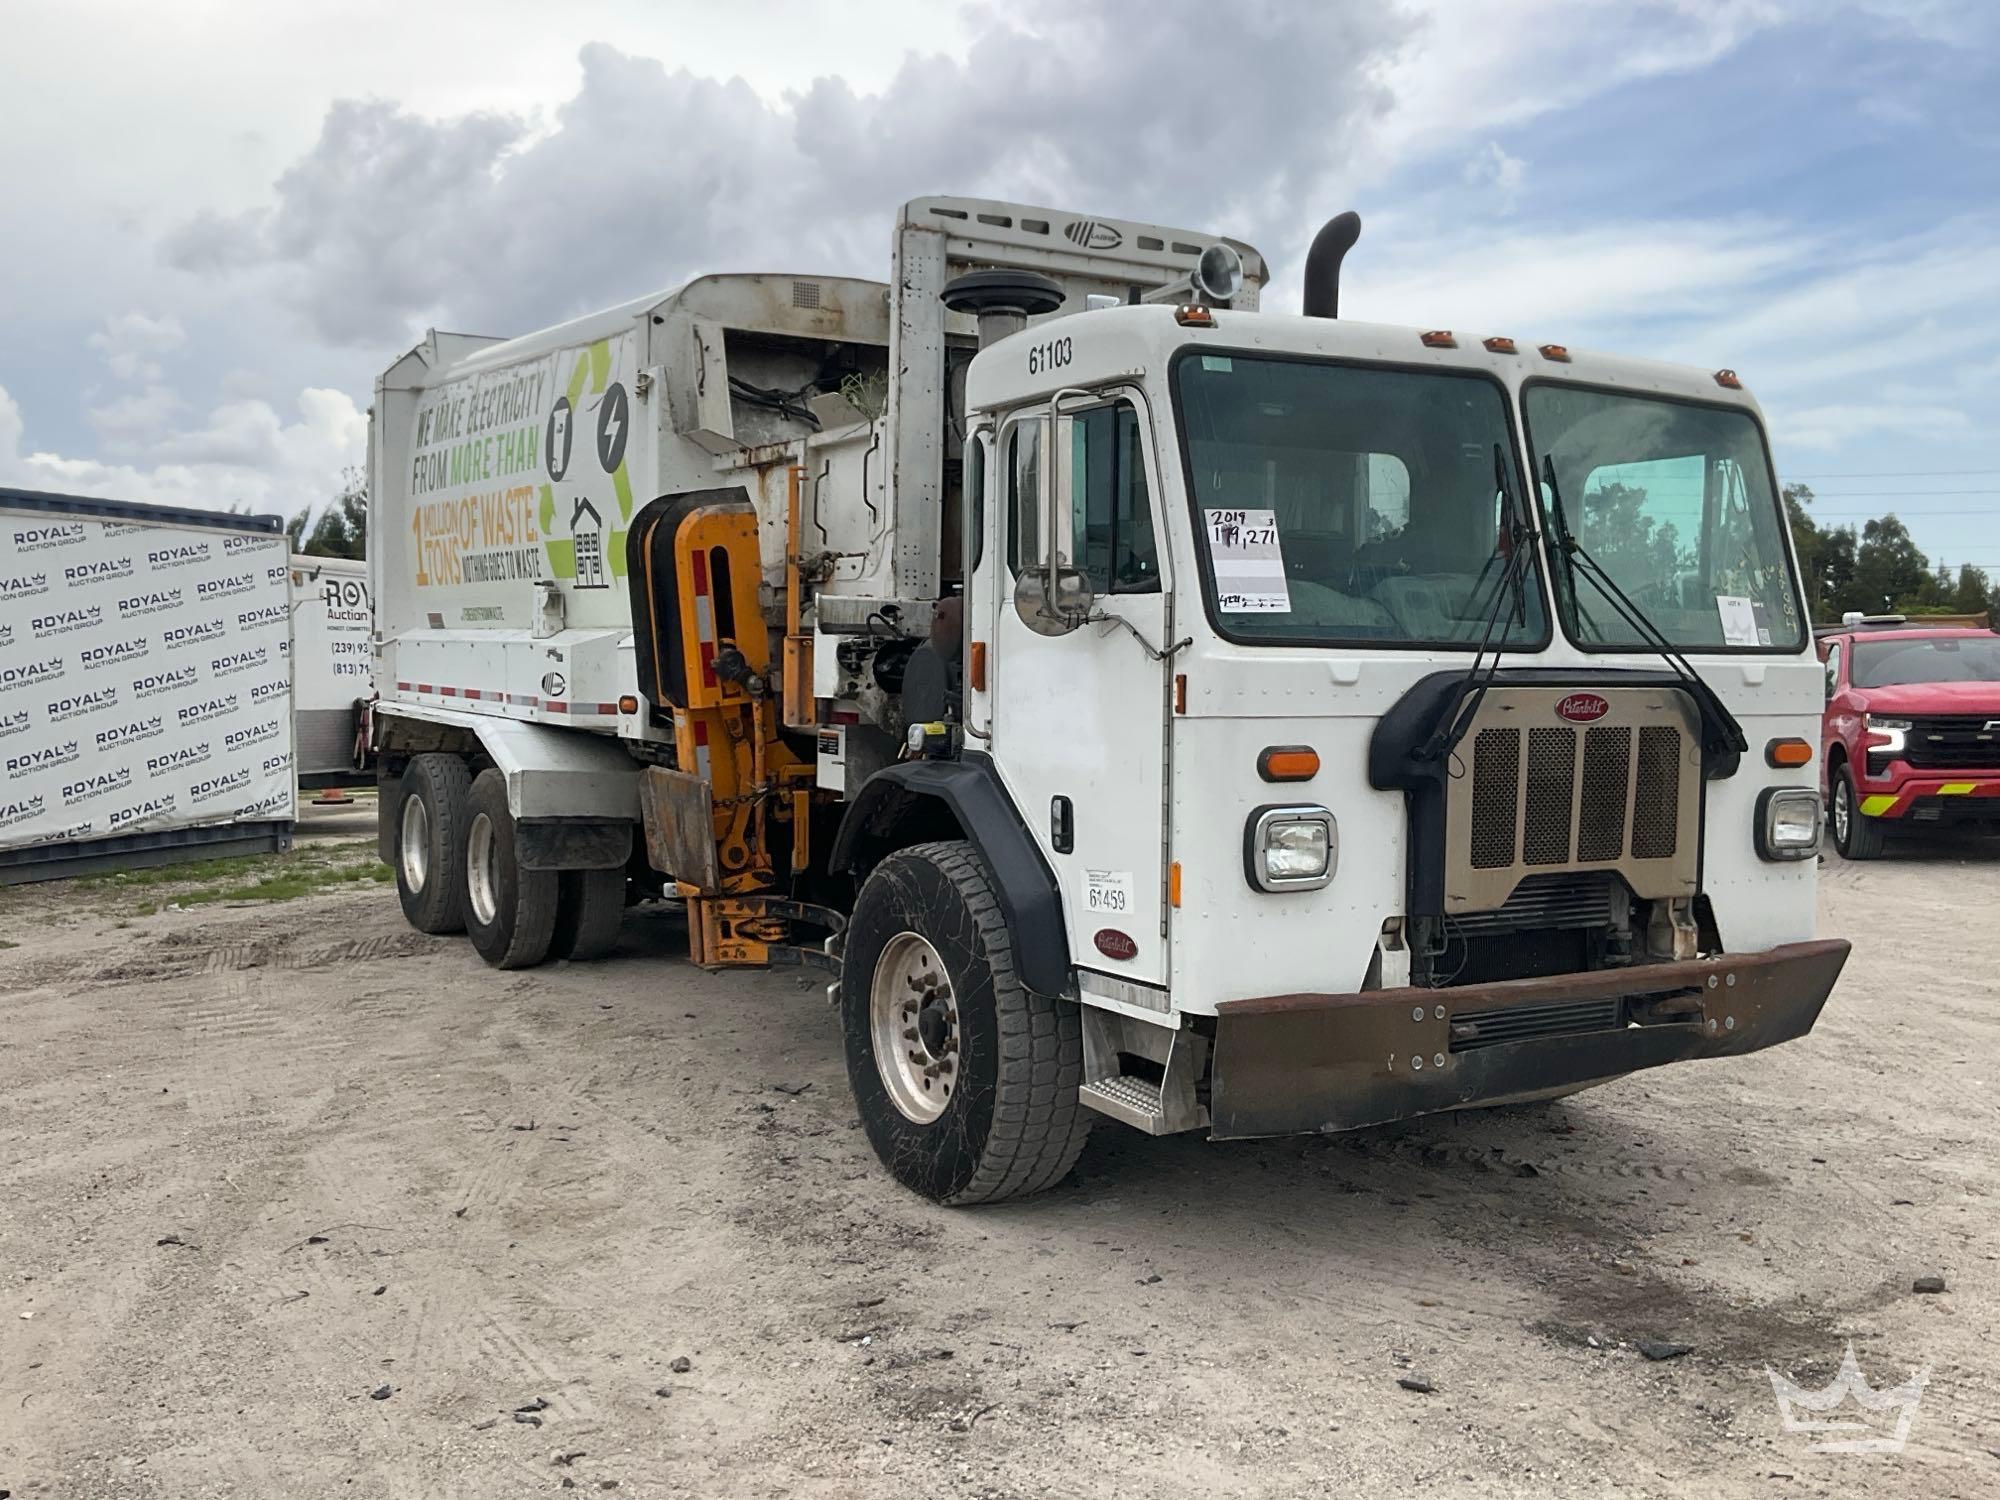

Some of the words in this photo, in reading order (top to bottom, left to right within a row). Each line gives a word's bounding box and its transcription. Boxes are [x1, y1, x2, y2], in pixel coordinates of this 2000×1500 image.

[1029, 336, 1072, 375] 61103
[417, 408, 433, 448] WE
[433, 398, 465, 444] MAKE
[466, 370, 545, 435] ELECTRICITY
[413, 449, 448, 495] FROM
[450, 437, 493, 486] MORE
[496, 424, 539, 477] THAN
[1211, 511, 1246, 525] 2019
[14, 526, 70, 544] ROYAL
[17, 541, 57, 553] AUCTION
[58, 536, 87, 546] GROUP
[412, 505, 428, 586] 1
[424, 500, 459, 538] MILLION
[460, 495, 478, 550] OF
[148, 545, 197, 564] ROYAL
[151, 560, 186, 571] AUCTION
[186, 555, 211, 565] GROUP
[425, 536, 460, 586] TONS
[505, 549, 515, 580] TO
[515, 547, 541, 579] WASTE
[65, 560, 118, 580] ROYAL
[68, 576, 104, 588] AUCTION
[106, 570, 134, 580] GROUP
[18, 587, 48, 598] GROUP
[197, 577, 243, 594] ROYAL
[200, 591, 231, 601] AUCTION
[232, 585, 255, 594] GROUP
[118, 591, 169, 611] ROYAL
[121, 606, 156, 619] AUCTION
[157, 601, 184, 612] GROUP
[32, 610, 87, 630] ROYAL
[238, 607, 280, 624] ROYAL
[328, 607, 367, 621] Auction
[35, 625, 73, 639] AUCTION
[74, 619, 103, 630] GROUP
[164, 623, 212, 642] ROYAL
[166, 638, 200, 650] AUCTION
[200, 631, 225, 641] GROUP
[331, 642, 355, 655] (239)
[357, 642, 368, 654] 93
[81, 642, 134, 662] ROYAL
[84, 657, 121, 670] AUCTION
[122, 649, 149, 661] GROUP
[211, 651, 256, 671] ROYAL
[35, 673, 64, 683] GROUP
[214, 666, 244, 678] AUCTION
[245, 659, 268, 669] GROUP
[333, 663, 356, 676] (813)
[133, 670, 184, 692] ROYAL
[136, 684, 171, 699] AUCTION
[172, 679, 198, 689] GROUP
[251, 680, 291, 698] ROYAL
[48, 692, 103, 715] ROYAL
[50, 708, 88, 723] AUCTION
[89, 699, 118, 712] GROUP
[178, 699, 226, 720] ROYAL
[1563, 698, 1605, 715] Peterbilt
[181, 715, 213, 727] AUCTION
[214, 706, 239, 718] GROUP
[96, 721, 149, 744] ROYAL
[98, 737, 135, 752] AUCTION
[135, 728, 164, 741] GROUP
[225, 724, 268, 745] ROYAL
[227, 739, 258, 752] AUCTION
[258, 730, 280, 742] GROUP
[6, 746, 64, 771] ROYAL
[9, 764, 48, 780] AUCTION
[50, 753, 80, 767] GROUP
[147, 748, 197, 771] ROYAL
[150, 763, 185, 778] AUCTION
[185, 754, 211, 767] GROUP
[62, 773, 117, 798] ROYAL
[64, 789, 102, 806] AUCTION
[103, 779, 132, 793] GROUP
[190, 773, 238, 796] ROYAL
[192, 788, 225, 804] AUCTION
[226, 779, 251, 793] GROUP
[15, 808, 46, 822] GROUP
[110, 800, 162, 824] ROYAL
[1089, 888, 1125, 910] 61459
